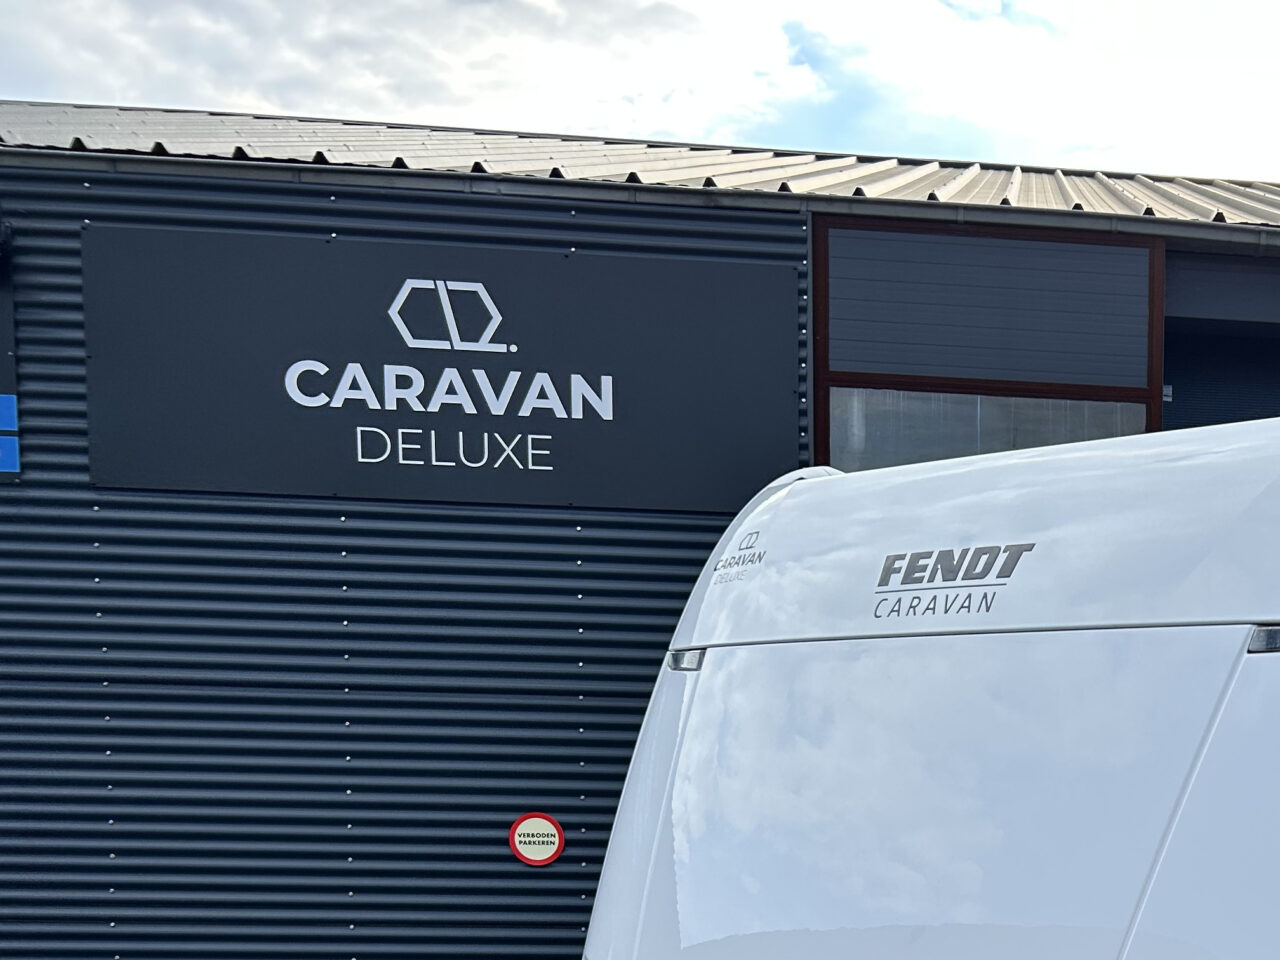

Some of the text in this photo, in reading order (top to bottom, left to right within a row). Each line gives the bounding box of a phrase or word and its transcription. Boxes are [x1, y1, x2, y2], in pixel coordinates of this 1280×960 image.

[284, 359, 614, 421] CARAVAN
[356, 426, 554, 471] DELUXE
[713, 550, 767, 572] CARAVAN
[877, 543, 1036, 588] FENDT
[874, 591, 996, 619] CARAVAN
